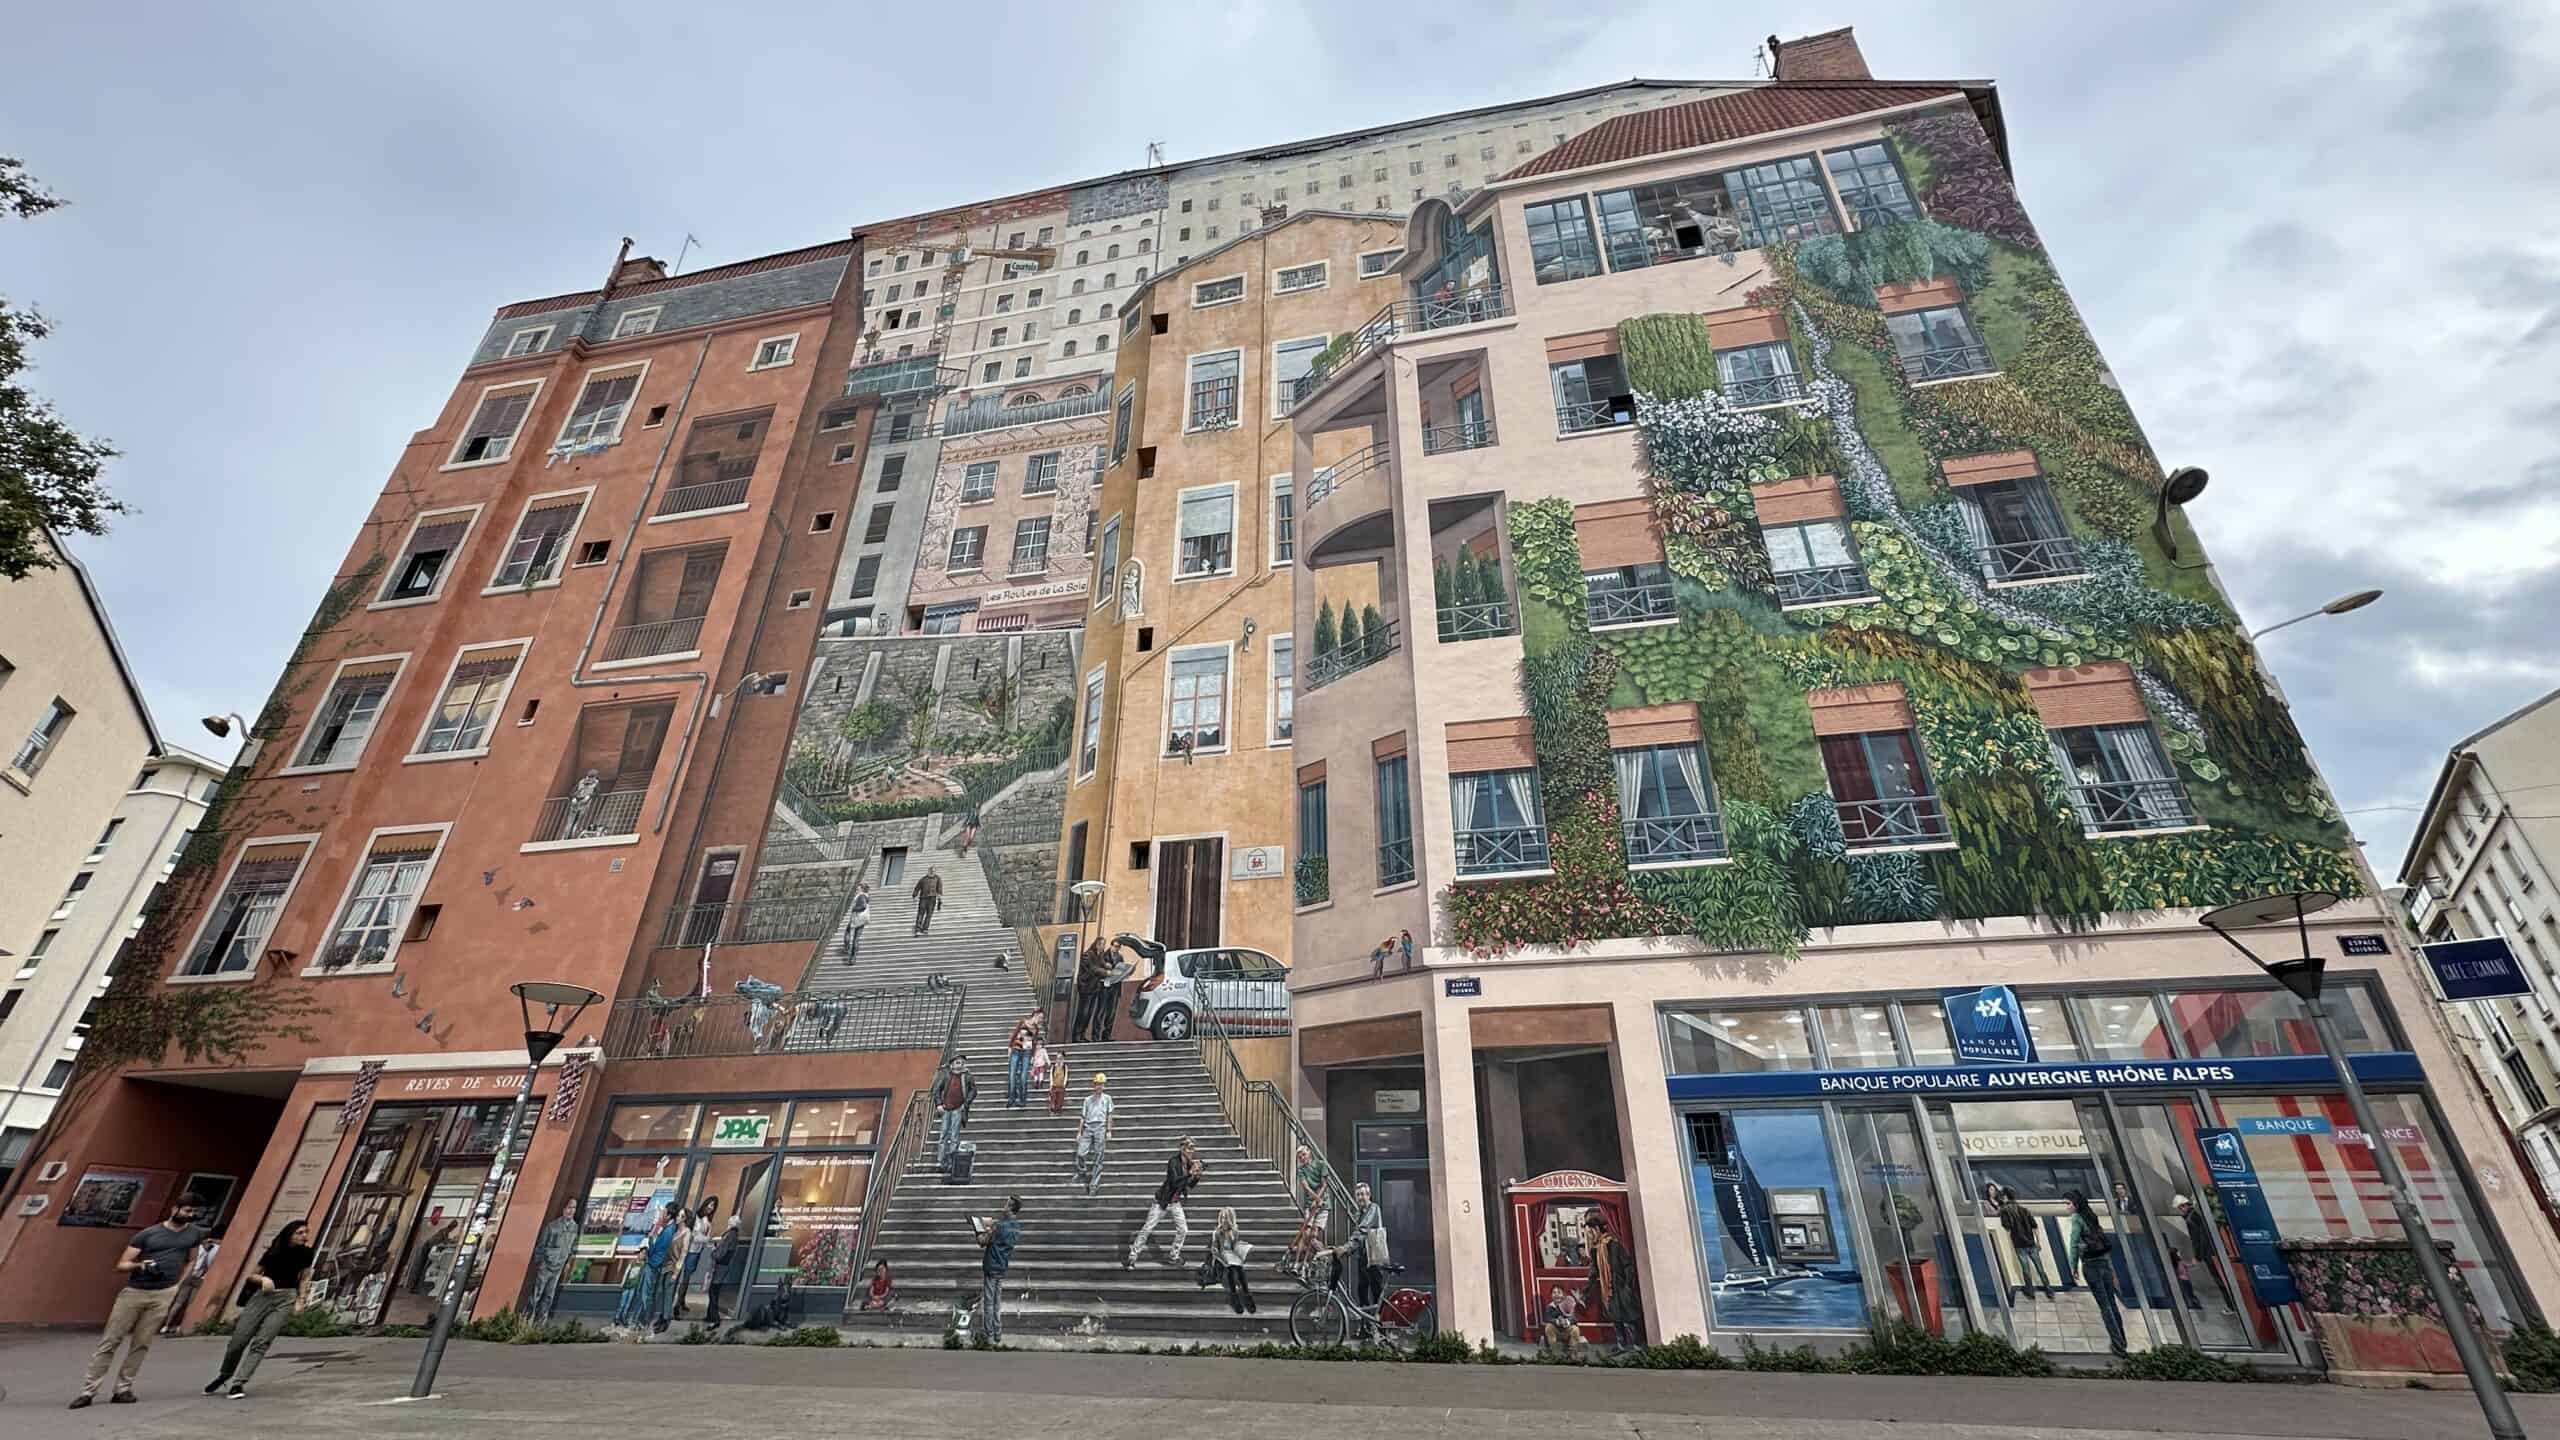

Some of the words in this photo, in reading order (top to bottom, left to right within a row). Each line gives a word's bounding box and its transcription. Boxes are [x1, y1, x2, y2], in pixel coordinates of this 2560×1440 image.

[985, 592, 1001, 602] Les
[1003, 589, 1037, 600] Routes
[1040, 586, 1051, 595] de
[1963, 1046, 2020, 1056] POPULAIRE
[404, 1078, 454, 1091] REVES
[461, 1076, 484, 1089] DE
[1820, 1076, 1889, 1091] BANQUE
[1892, 1073, 1981, 1088] POPULAIRE
[1988, 1070, 2093, 1086] AUVERGNE
[2096, 1065, 2168, 1083] RHÔNE
[2172, 1066, 2235, 1081] ALPES
[2255, 1119, 2315, 1130] BANQUE
[2338, 1128, 2416, 1140] ASSNCE
[1937, 1135, 2011, 1150] BNQUE
[1463, 1199, 1471, 1213] 3
[1733, 1184, 1748, 1219] BANQUE
